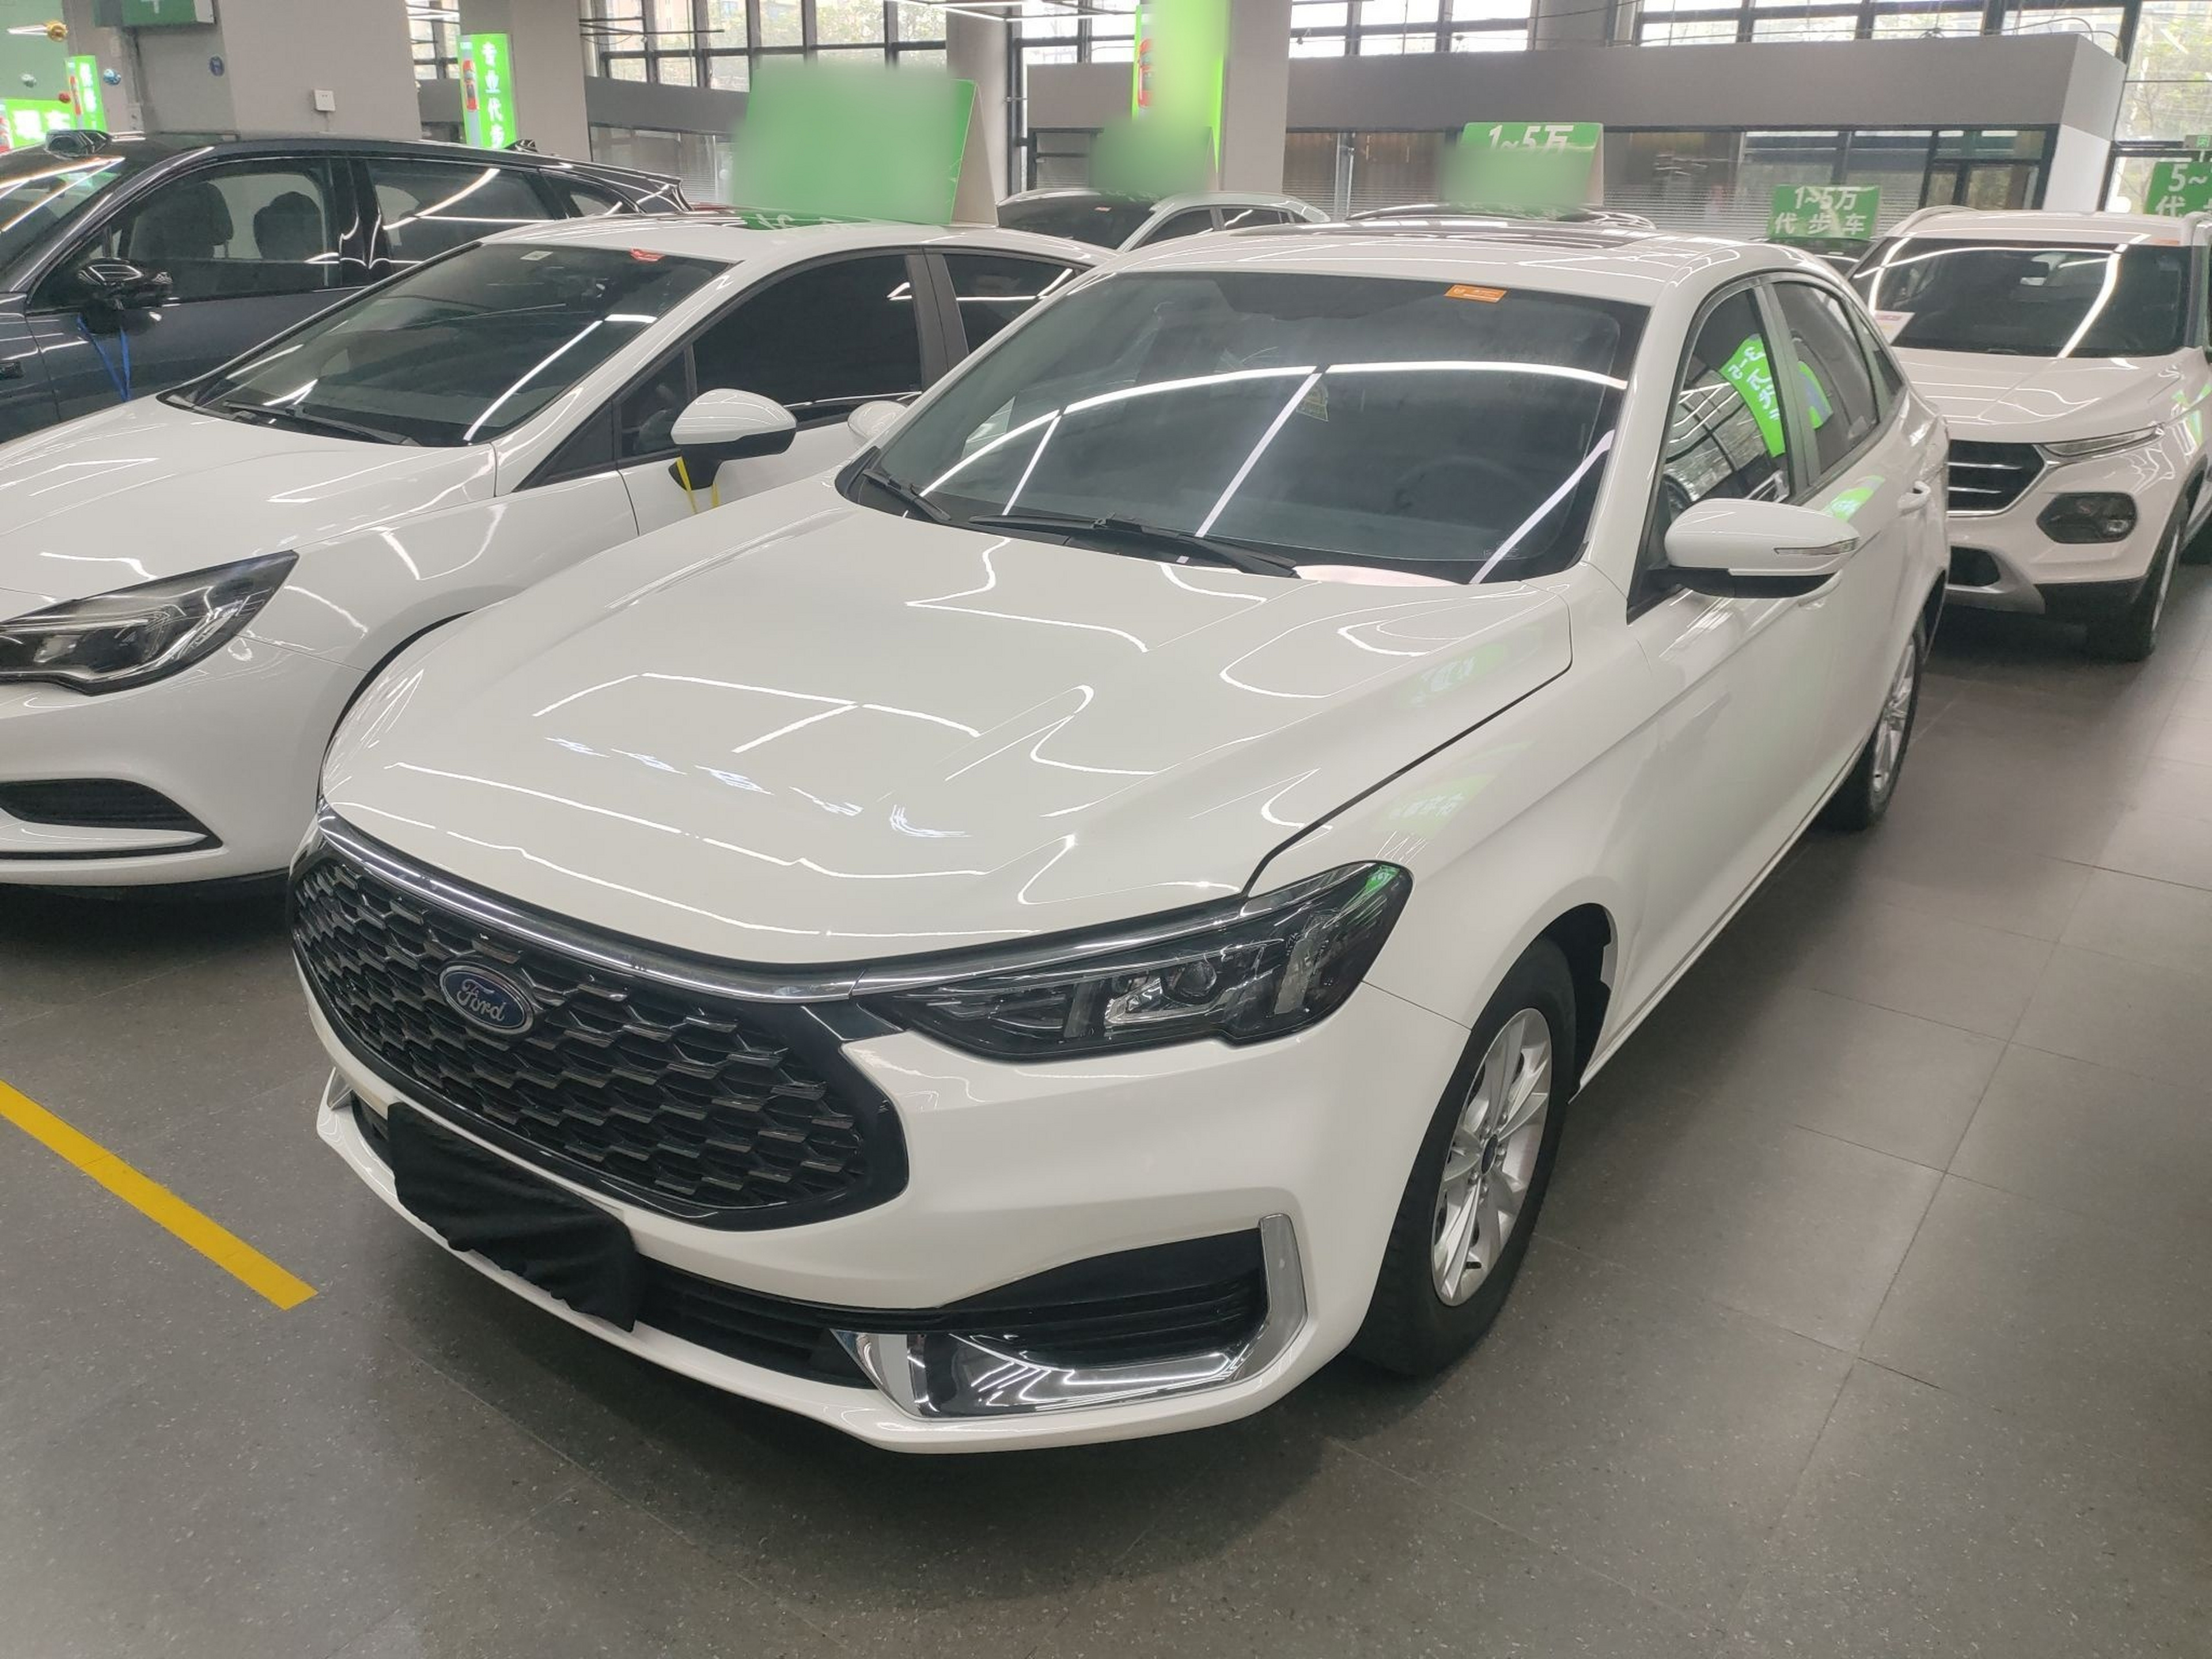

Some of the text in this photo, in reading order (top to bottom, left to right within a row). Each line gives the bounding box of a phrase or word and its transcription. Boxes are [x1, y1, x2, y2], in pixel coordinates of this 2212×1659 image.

[2168, 163, 2212, 192] 5~
[1775, 212, 1866, 235] 代步车
[457, 979, 507, 1021] Ford
